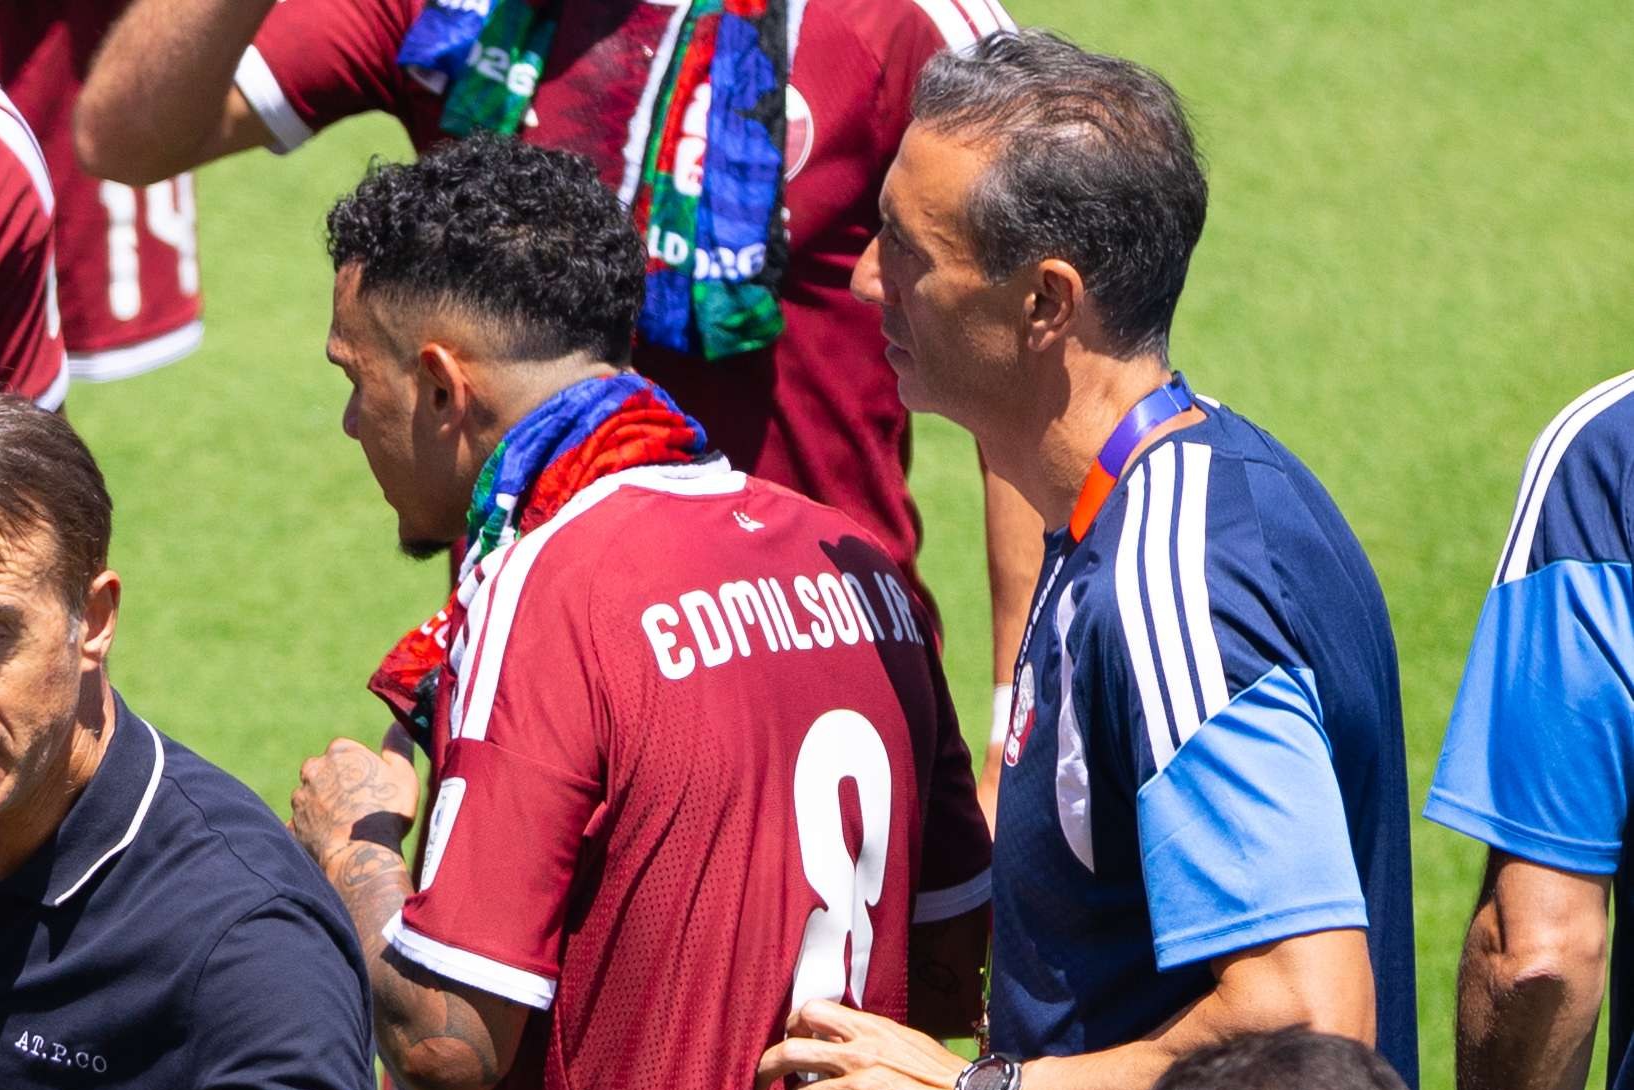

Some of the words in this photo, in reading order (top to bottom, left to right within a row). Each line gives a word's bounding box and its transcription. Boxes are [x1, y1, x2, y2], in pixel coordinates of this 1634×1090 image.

[99, 171, 200, 321] 14
[641, 571, 885, 680] EDMILSON
[14, 1030, 107, 1072] AT.P.CO
